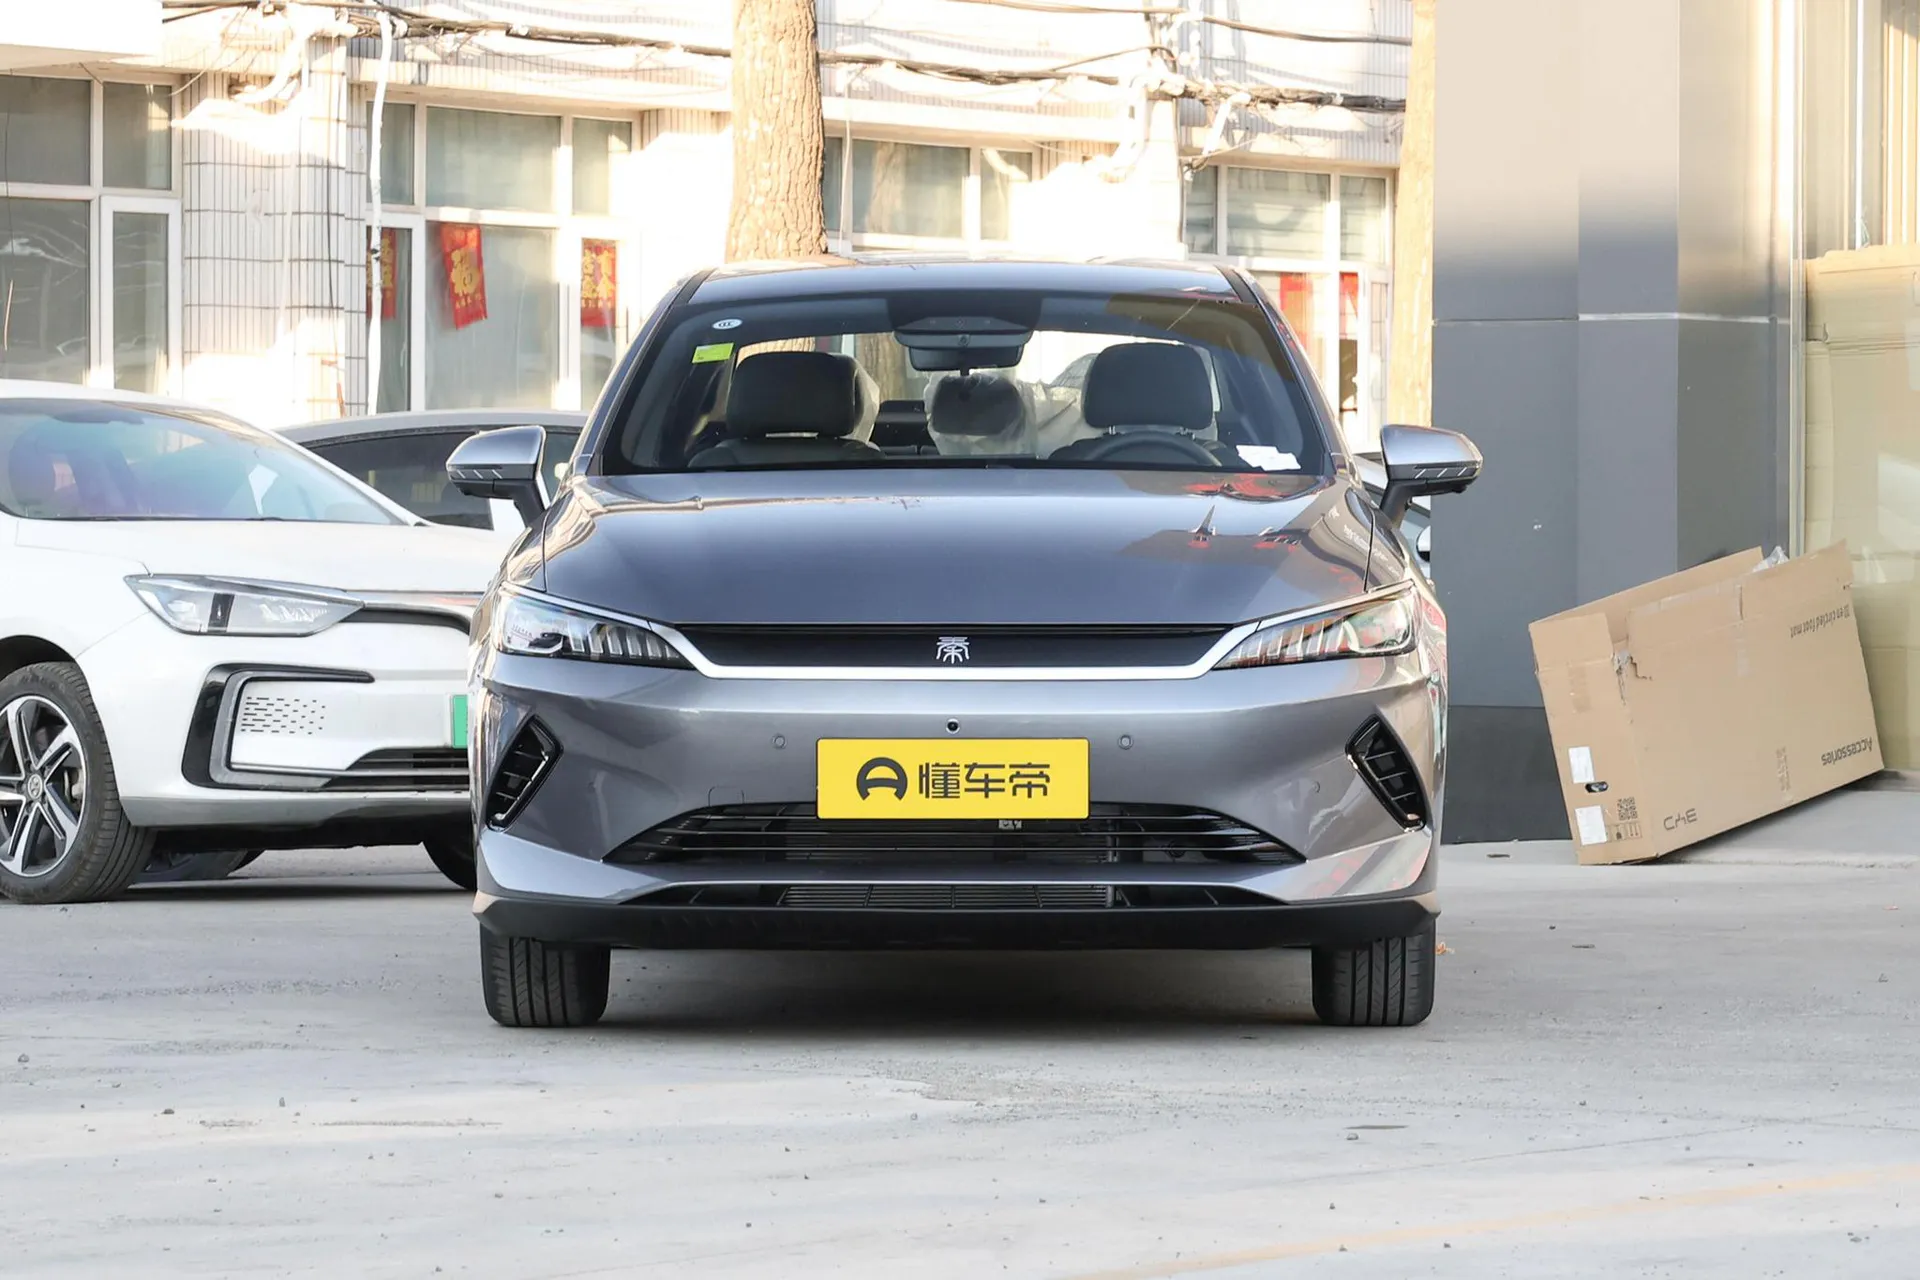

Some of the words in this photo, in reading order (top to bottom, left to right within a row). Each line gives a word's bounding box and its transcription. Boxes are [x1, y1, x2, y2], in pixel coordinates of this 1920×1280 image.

[1821, 737, 1873, 765] Accessories
[918, 762, 1051, 799] 懂车帝
